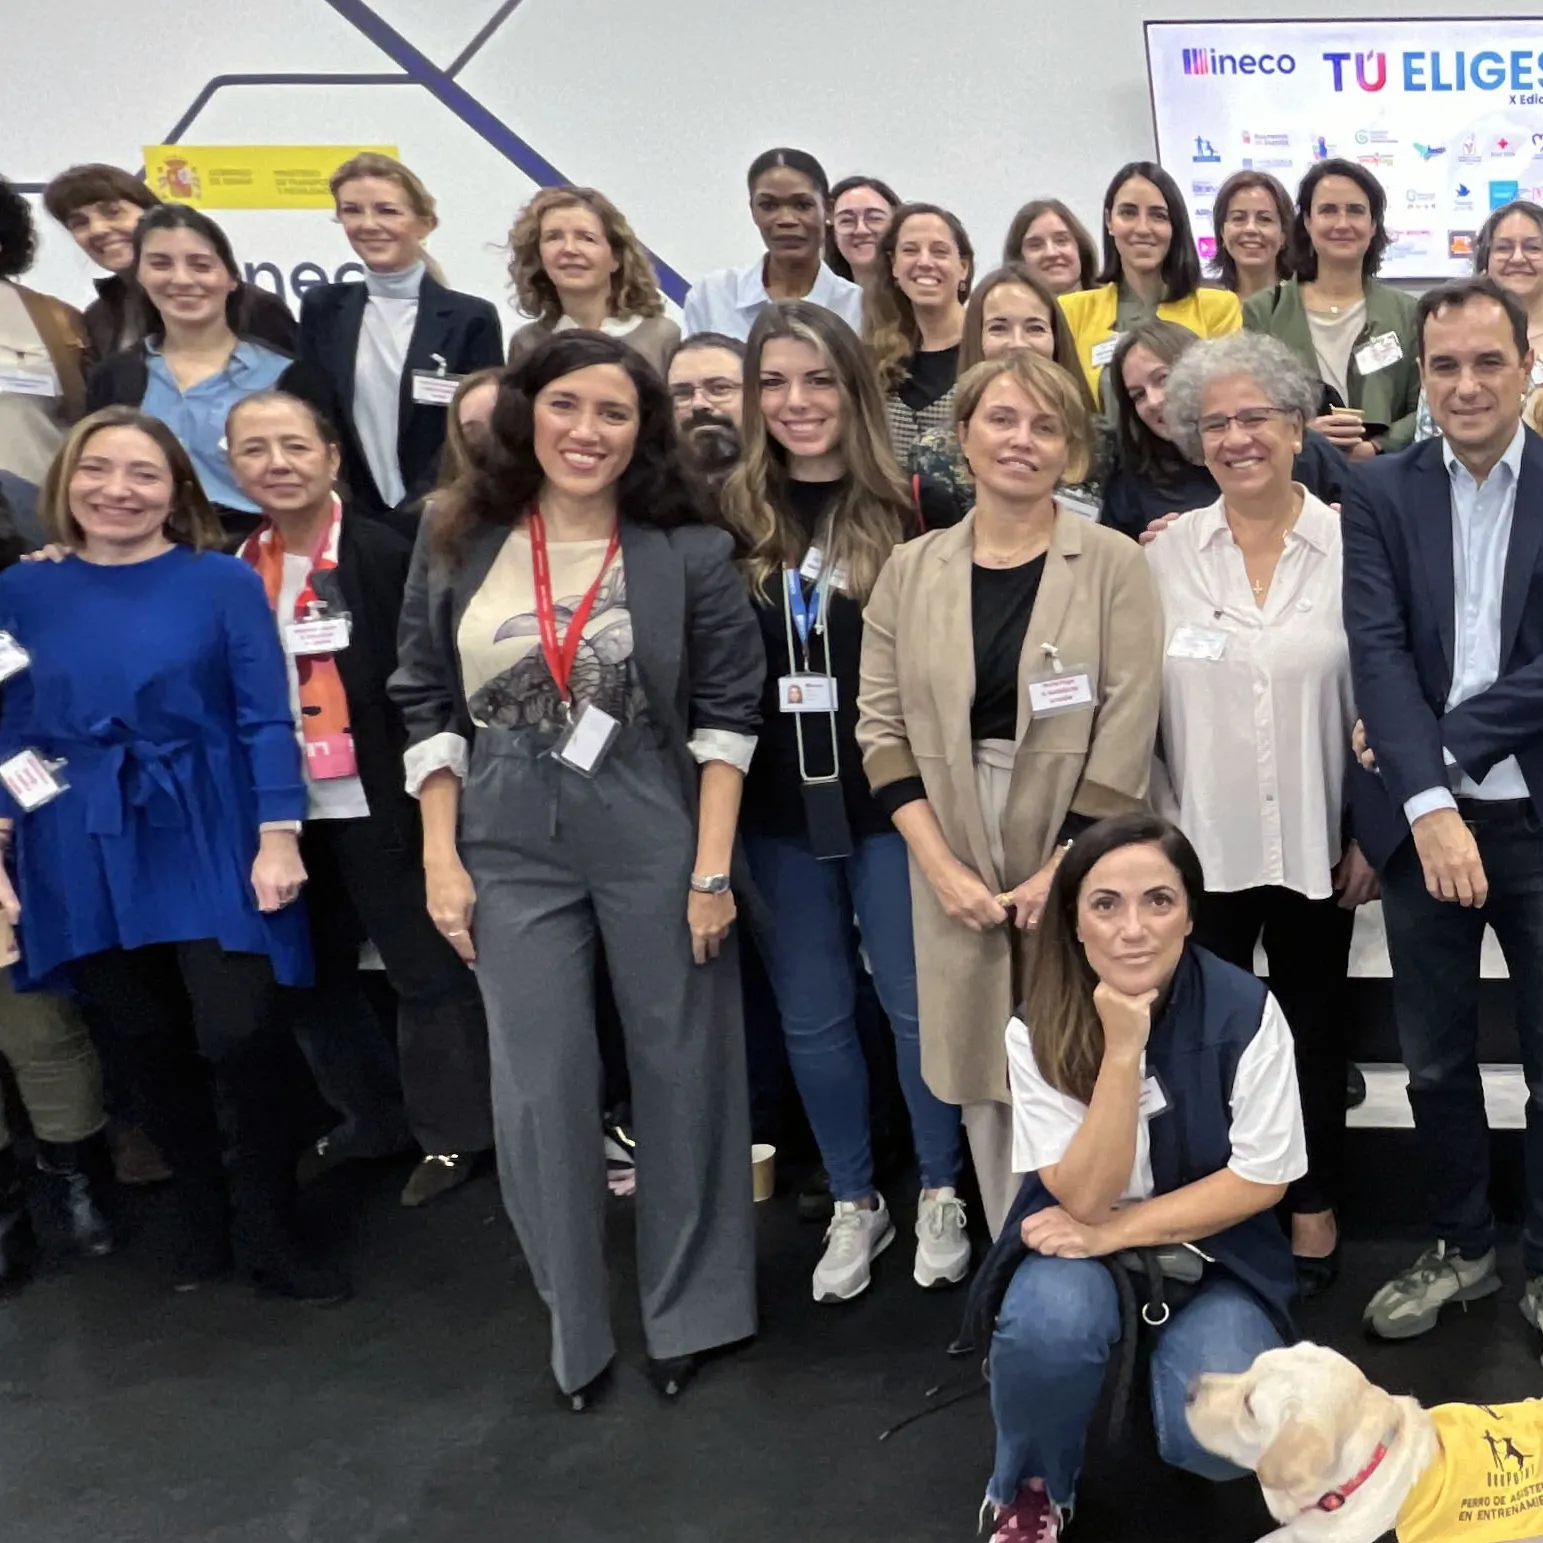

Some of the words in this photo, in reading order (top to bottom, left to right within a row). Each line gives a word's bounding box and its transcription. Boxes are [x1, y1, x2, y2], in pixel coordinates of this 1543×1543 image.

[1210, 48, 1296, 75] ineco
[1323, 49, 1387, 92] TÚ
[1509, 95, 1517, 105] X
[1460, 1496, 1491, 1509] PERRO
[1493, 1495, 1507, 1506] DE
[1458, 1511, 1473, 1522] EN
